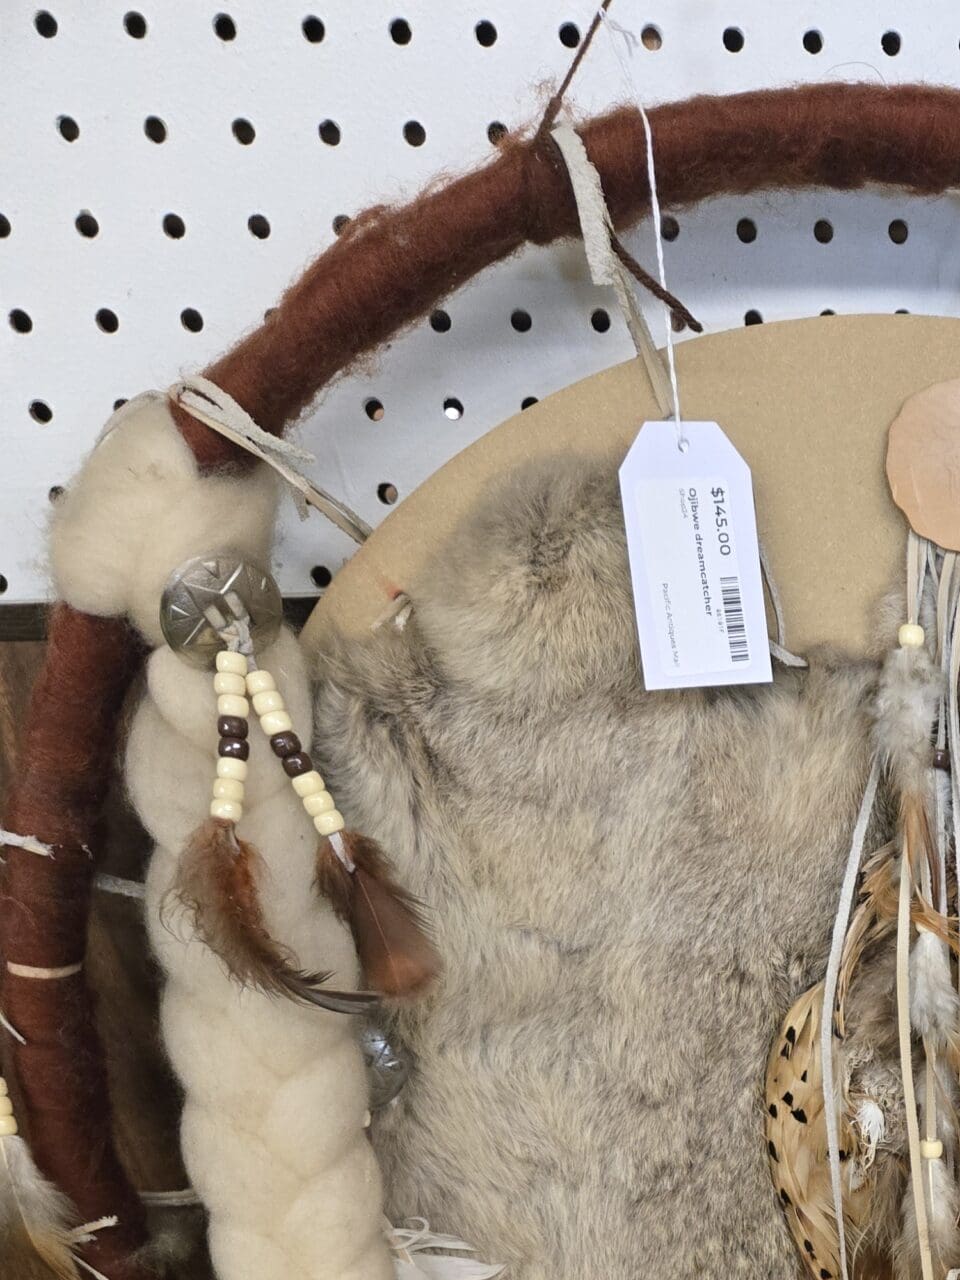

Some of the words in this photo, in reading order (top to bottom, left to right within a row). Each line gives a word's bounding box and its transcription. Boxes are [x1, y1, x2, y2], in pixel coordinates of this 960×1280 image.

[688, 488, 699, 530] Ojibwe
[695, 534, 712, 616] dreamcatcher
[710, 487, 731, 556] $145.00
